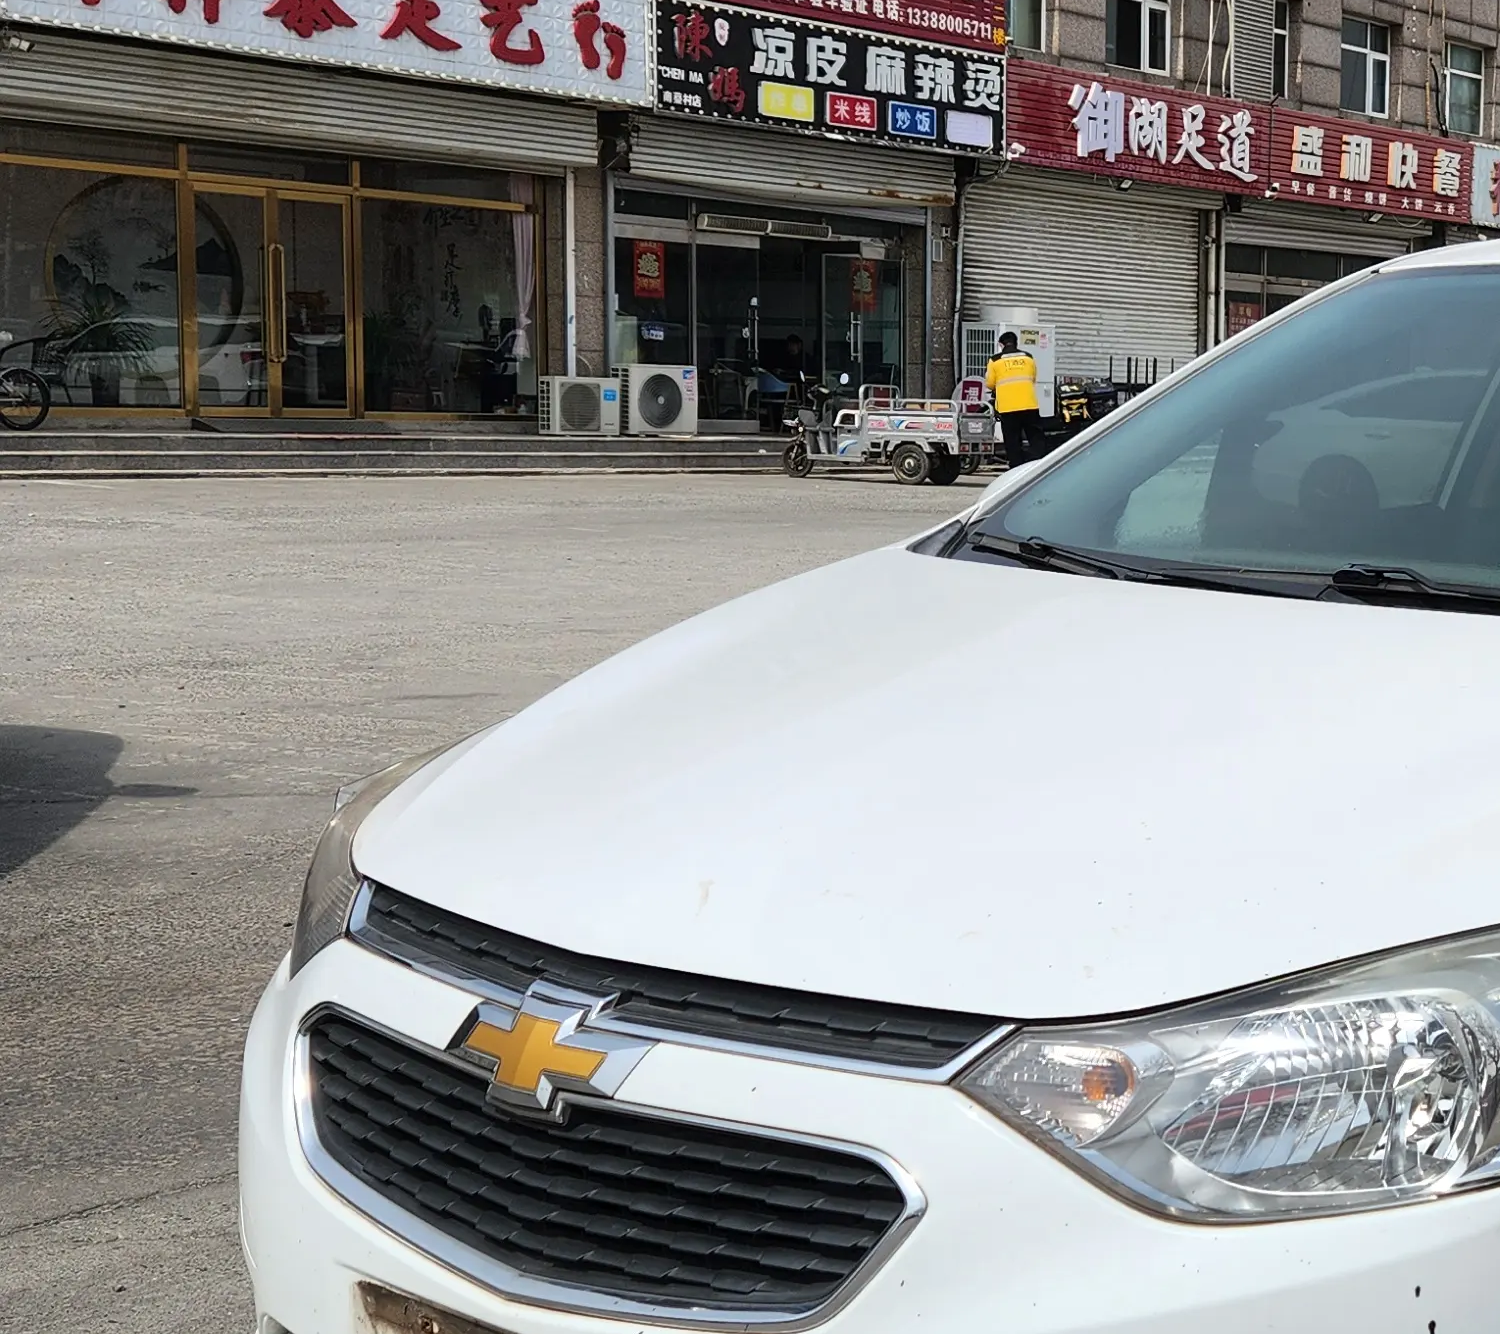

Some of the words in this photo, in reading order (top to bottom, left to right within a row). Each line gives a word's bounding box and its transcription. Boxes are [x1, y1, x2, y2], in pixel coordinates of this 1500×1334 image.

[661, 66, 685, 81] CHEN
[688, 70, 704, 84] MA
[750, 27, 847, 87] 凉皮
[865, 46, 1000, 111] 麻辣烫
[834, 98, 872, 124] 米线
[895, 107, 931, 133] 炒饭
[1067, 81, 1259, 183] 御湖足道
[1291, 125, 1462, 197] 盛和快餐
[1291, 181, 1316, 196] 早餐
[1434, 201, 1456, 215] 云吞
